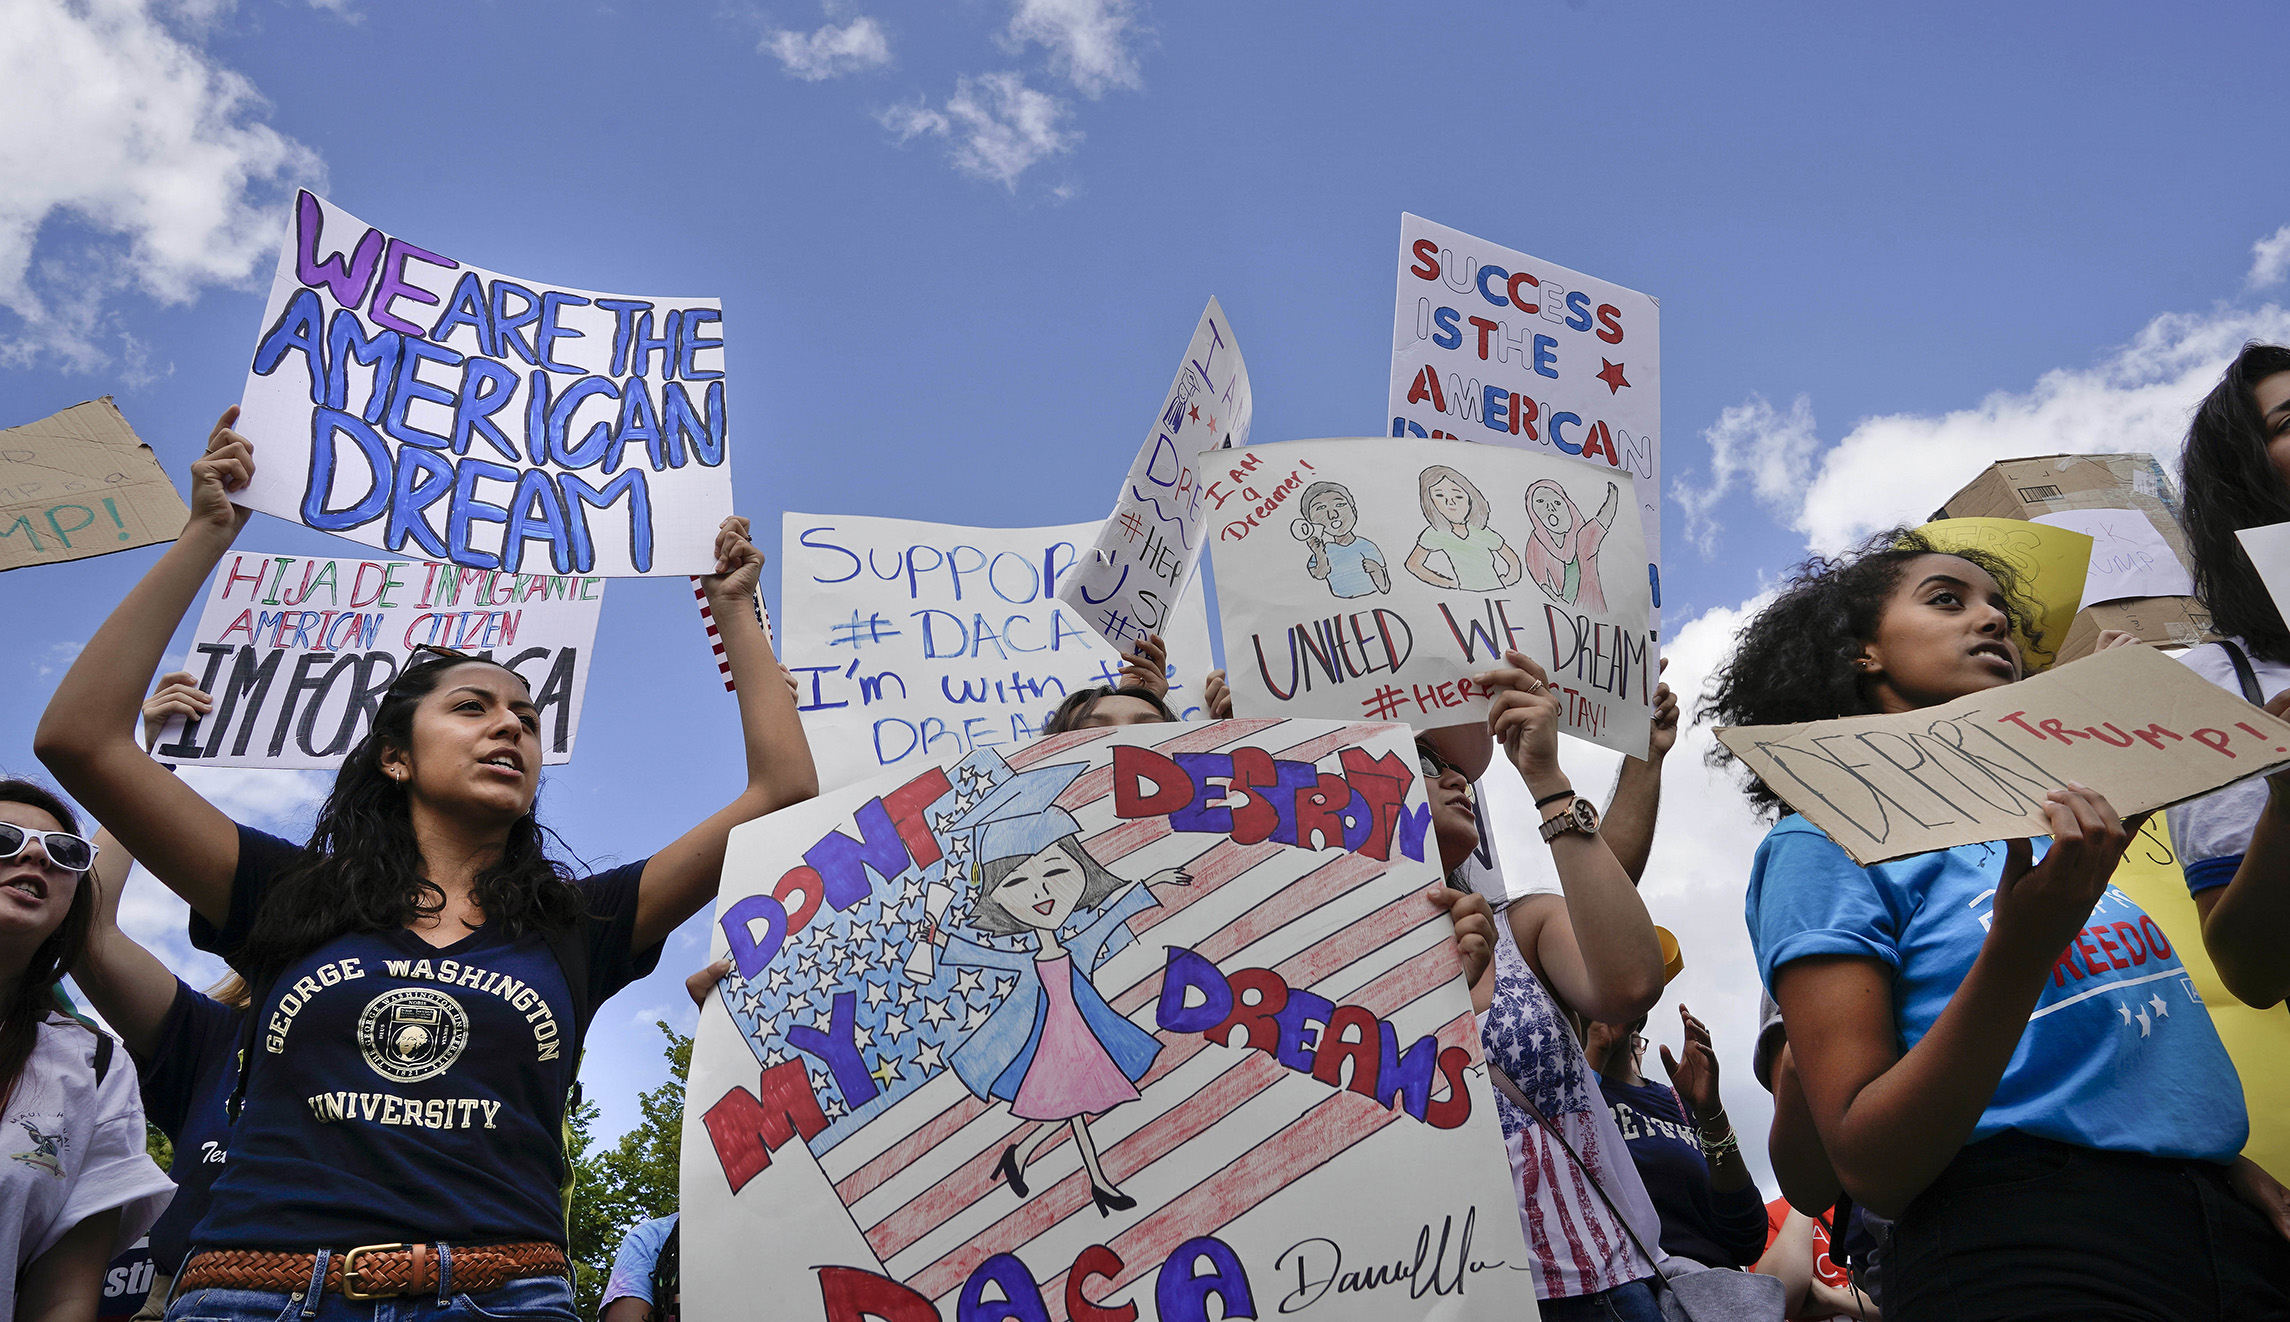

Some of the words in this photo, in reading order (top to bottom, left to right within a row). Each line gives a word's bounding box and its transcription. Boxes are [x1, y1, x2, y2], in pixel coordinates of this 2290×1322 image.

[296, 190, 459, 337] WE
[430, 272, 591, 375] ARE
[594, 299, 726, 381] THE
[1411, 239, 1624, 344] SUCCESS
[1416, 297, 1462, 350] IS
[1468, 315, 1559, 379] THE
[252, 288, 727, 474] AMERICAN
[1407, 364, 1652, 479] AMERICAN
[300, 405, 653, 574] DREAM
[1204, 481, 1236, 510] I
[1229, 452, 1264, 484] AM
[1220, 459, 1316, 541] Dreamer!
[800, 527, 1079, 604] SUPPOR
[1119, 512, 1183, 588] #HER
[2077, 521, 2139, 546] CK
[2087, 551, 2154, 577] UMP
[223, 555, 338, 607] HIJA
[350, 560, 410, 609] DE
[413, 561, 602, 609] INMIGRANTE
[1131, 590, 1169, 636] ST
[217, 608, 385, 651] AMERICAN
[404, 609, 523, 651] CITIZEN
[1251, 607, 1414, 700] UNITED
[1437, 598, 1525, 664] WE
[1543, 603, 1649, 706] DREAM
[267, 650, 399, 758] FOR
[942, 672, 1067, 704] with
[1754, 709, 2070, 844] DEPORT
[1998, 710, 2288, 759] TRUMP!
[719, 766, 954, 981] DONT
[2051, 914, 2172, 987] REEDO
[265, 957, 366, 1055] GEORGE
[382, 958, 561, 1062] WASHINGTON
[363, 1006, 381, 1047] GEORGE
[382, 991, 454, 1011] WASHINGTON
[432, 1013, 463, 1070] UNIVERSITY
[308, 1090, 502, 1131] UNIVERSITY
[700, 990, 880, 1196] MY
[1155, 945, 1476, 1130] DREAMS
